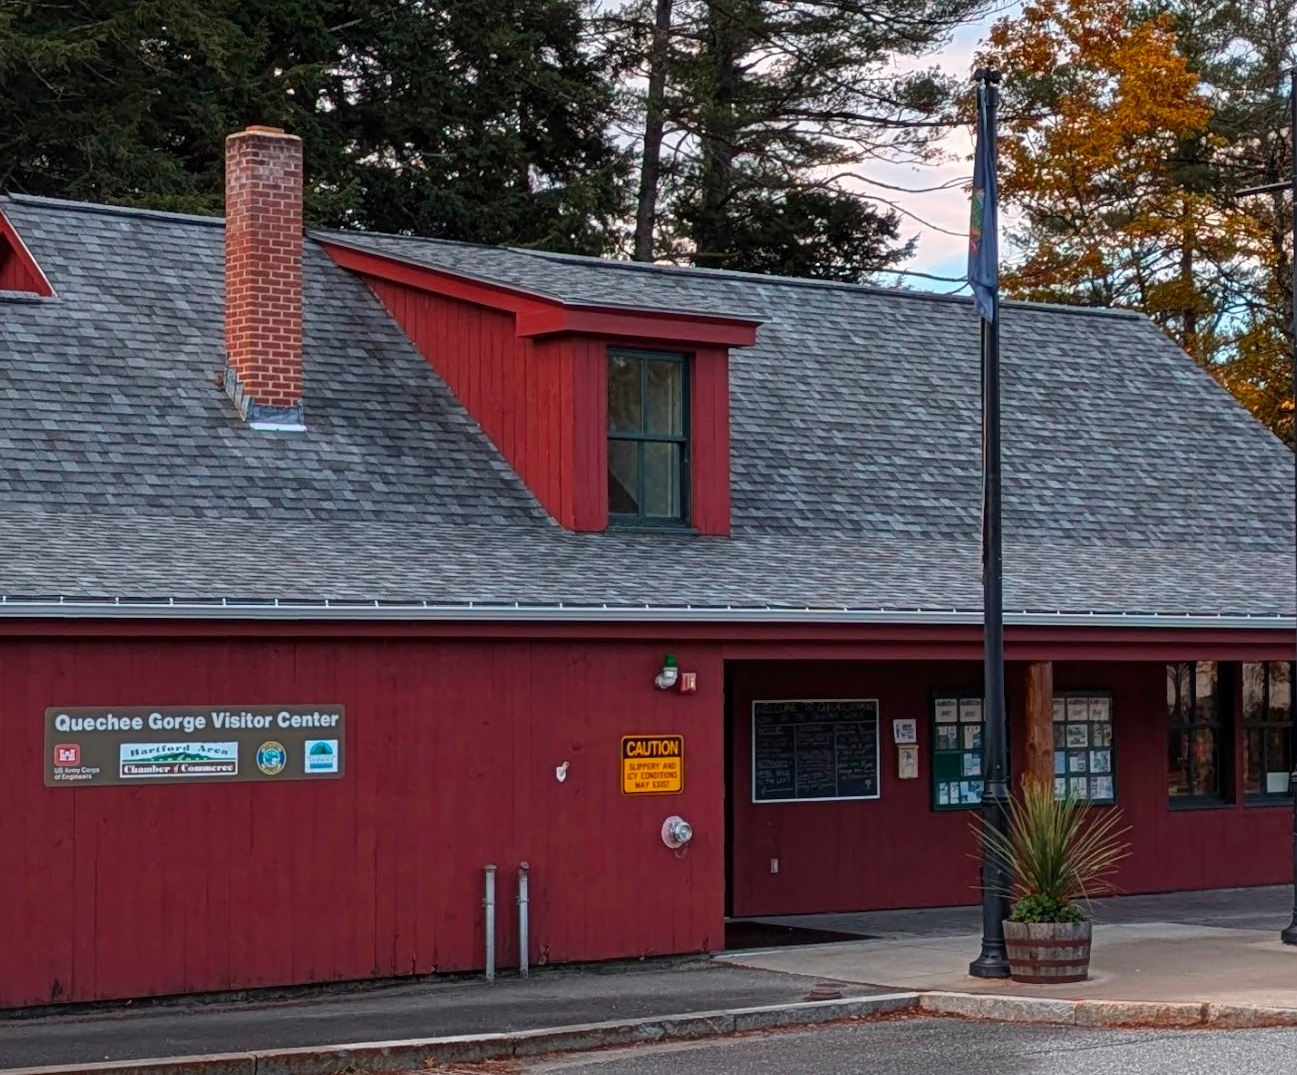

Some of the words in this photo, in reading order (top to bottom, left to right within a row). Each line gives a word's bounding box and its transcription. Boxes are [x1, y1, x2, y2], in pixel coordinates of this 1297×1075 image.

[55, 714, 143, 732] Quechee
[148, 713, 206, 732] Gorge
[211, 712, 272, 729] Visitor
[277, 711, 339, 728] Center
[130, 744, 190, 757] Hartford
[198, 745, 229, 756] Area
[626, 740, 678, 756] CAUTION
[81, 766, 100, 774] Corps
[123, 764, 171, 774] Chamber
[181, 763, 233, 773] Commerce
[629, 762, 660, 771] SLIPPERY
[662, 762, 676, 770] AND
[62, 773, 92, 781] Engineers
[627, 772, 638, 780] ICY
[641, 771, 677, 780] CONDITIONS
[635, 781, 650, 789] MAY
[653, 780, 670, 789] EXIST
